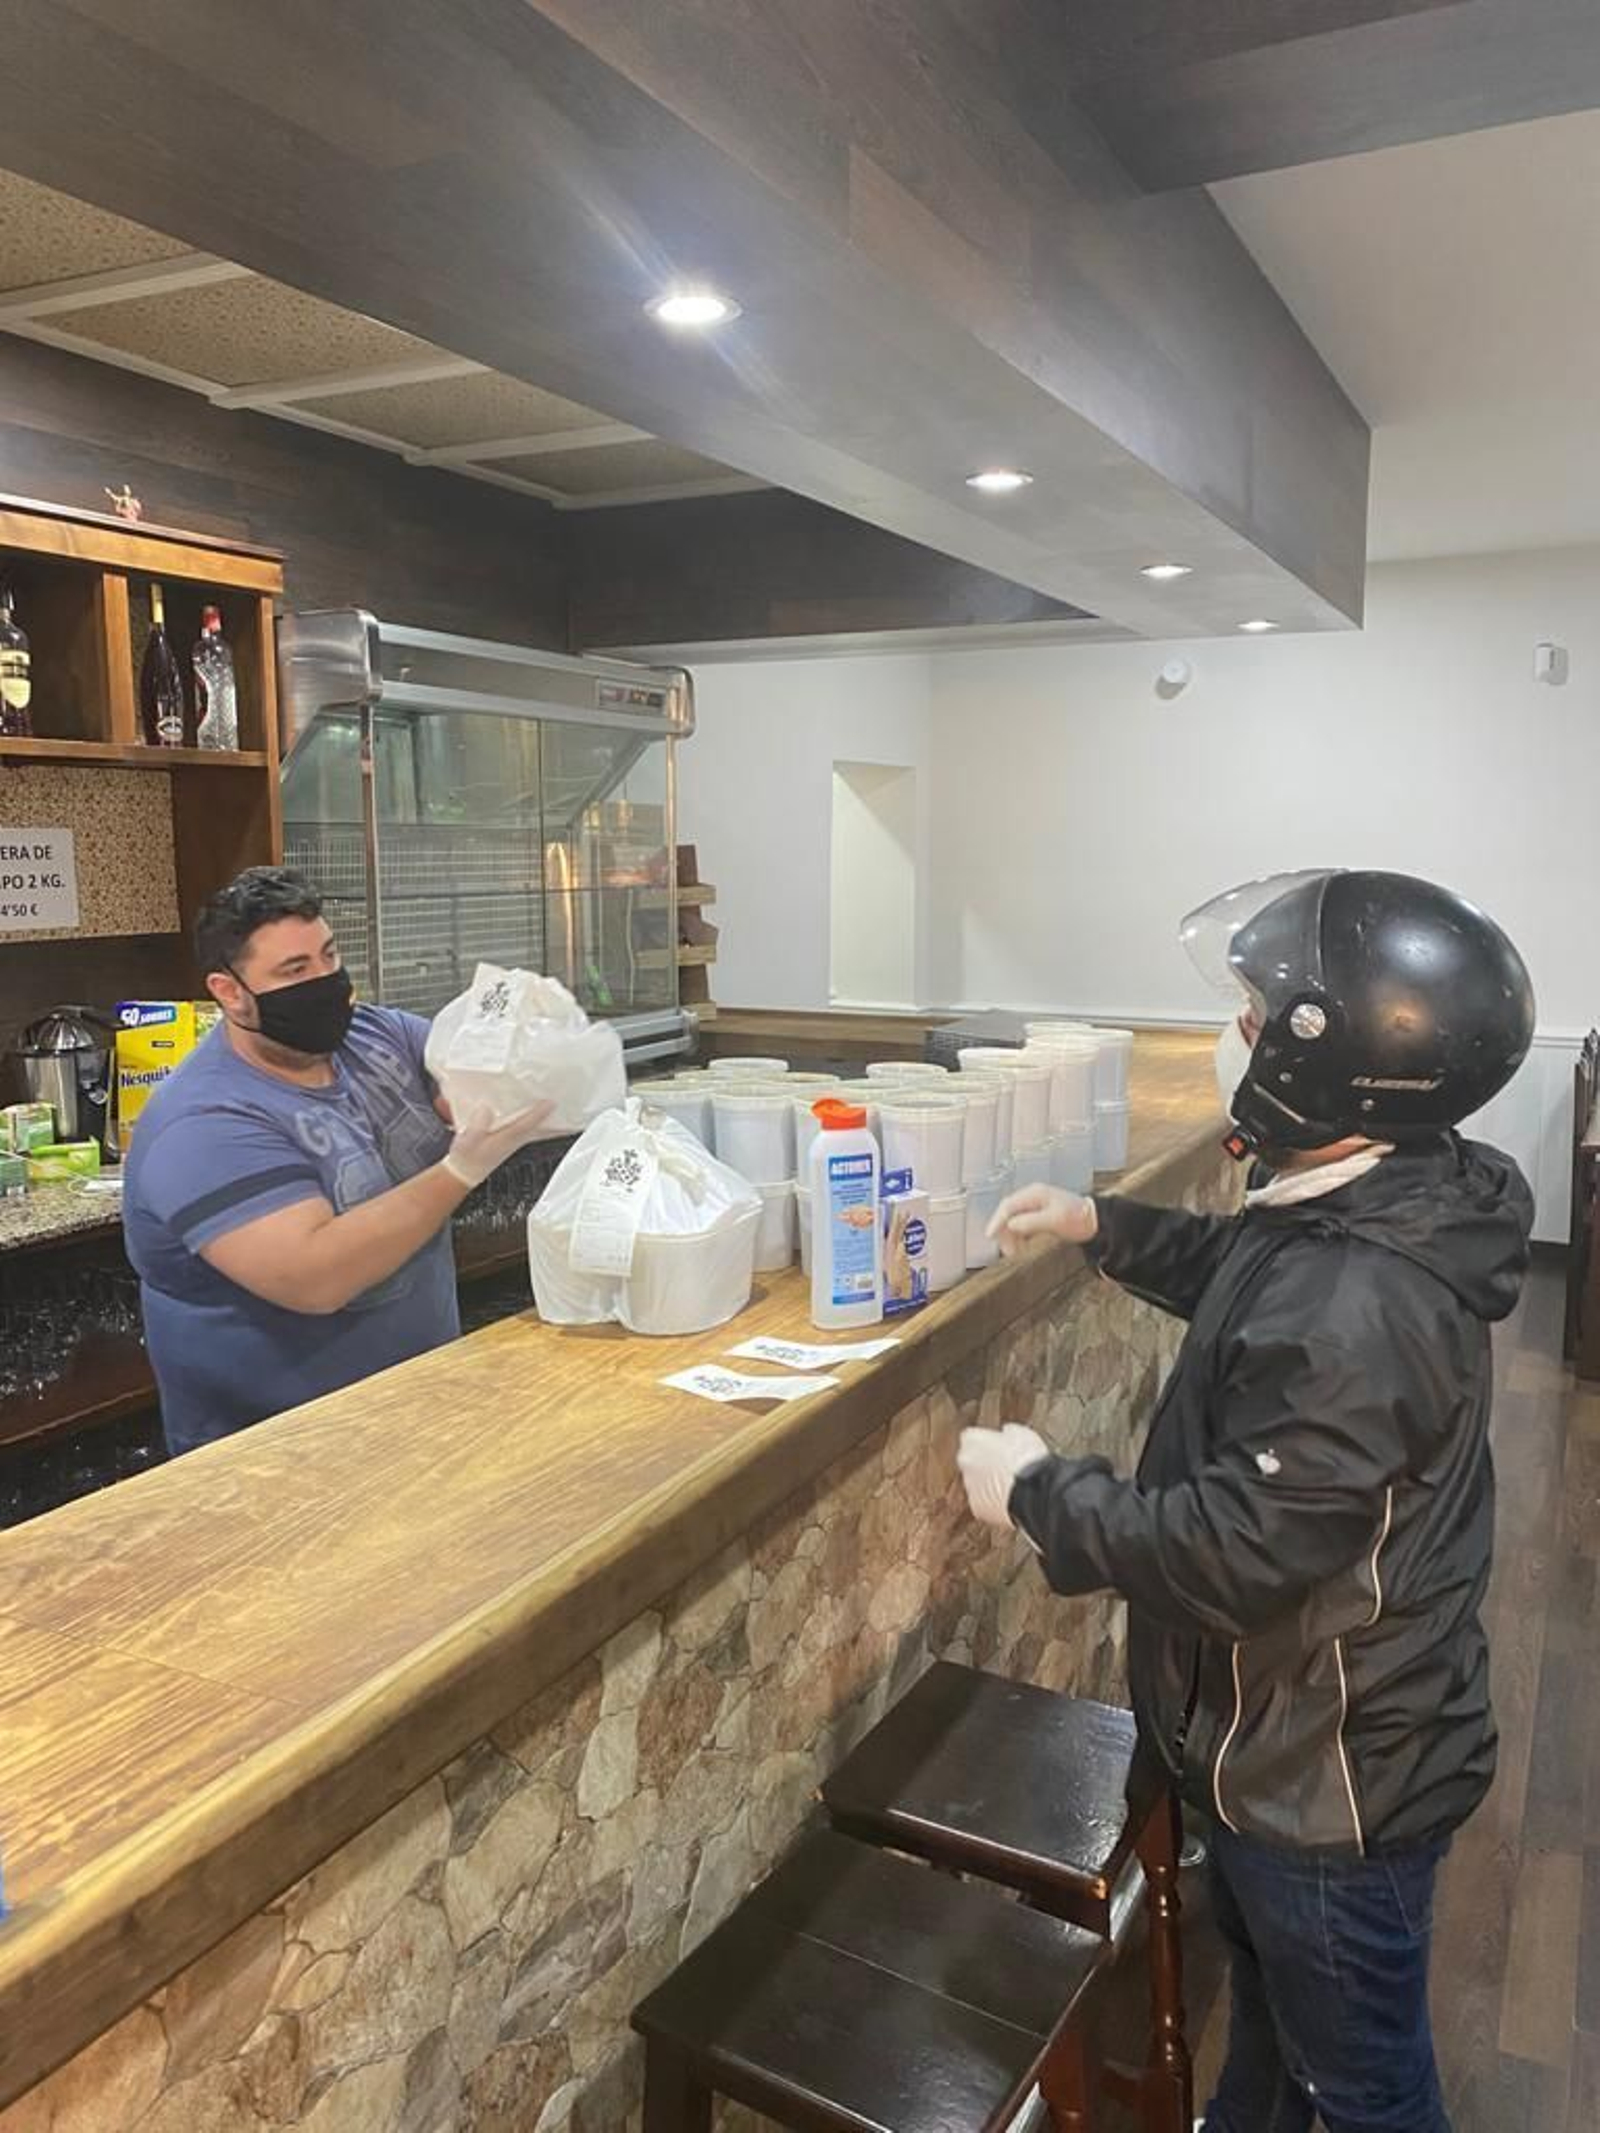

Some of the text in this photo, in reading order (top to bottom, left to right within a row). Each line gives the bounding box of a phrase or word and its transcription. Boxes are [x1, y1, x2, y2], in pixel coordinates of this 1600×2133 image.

[33, 845, 53, 860] DE
[0, 873, 66, 890] PO 2 KG.
[30, 902, 39, 917] €
